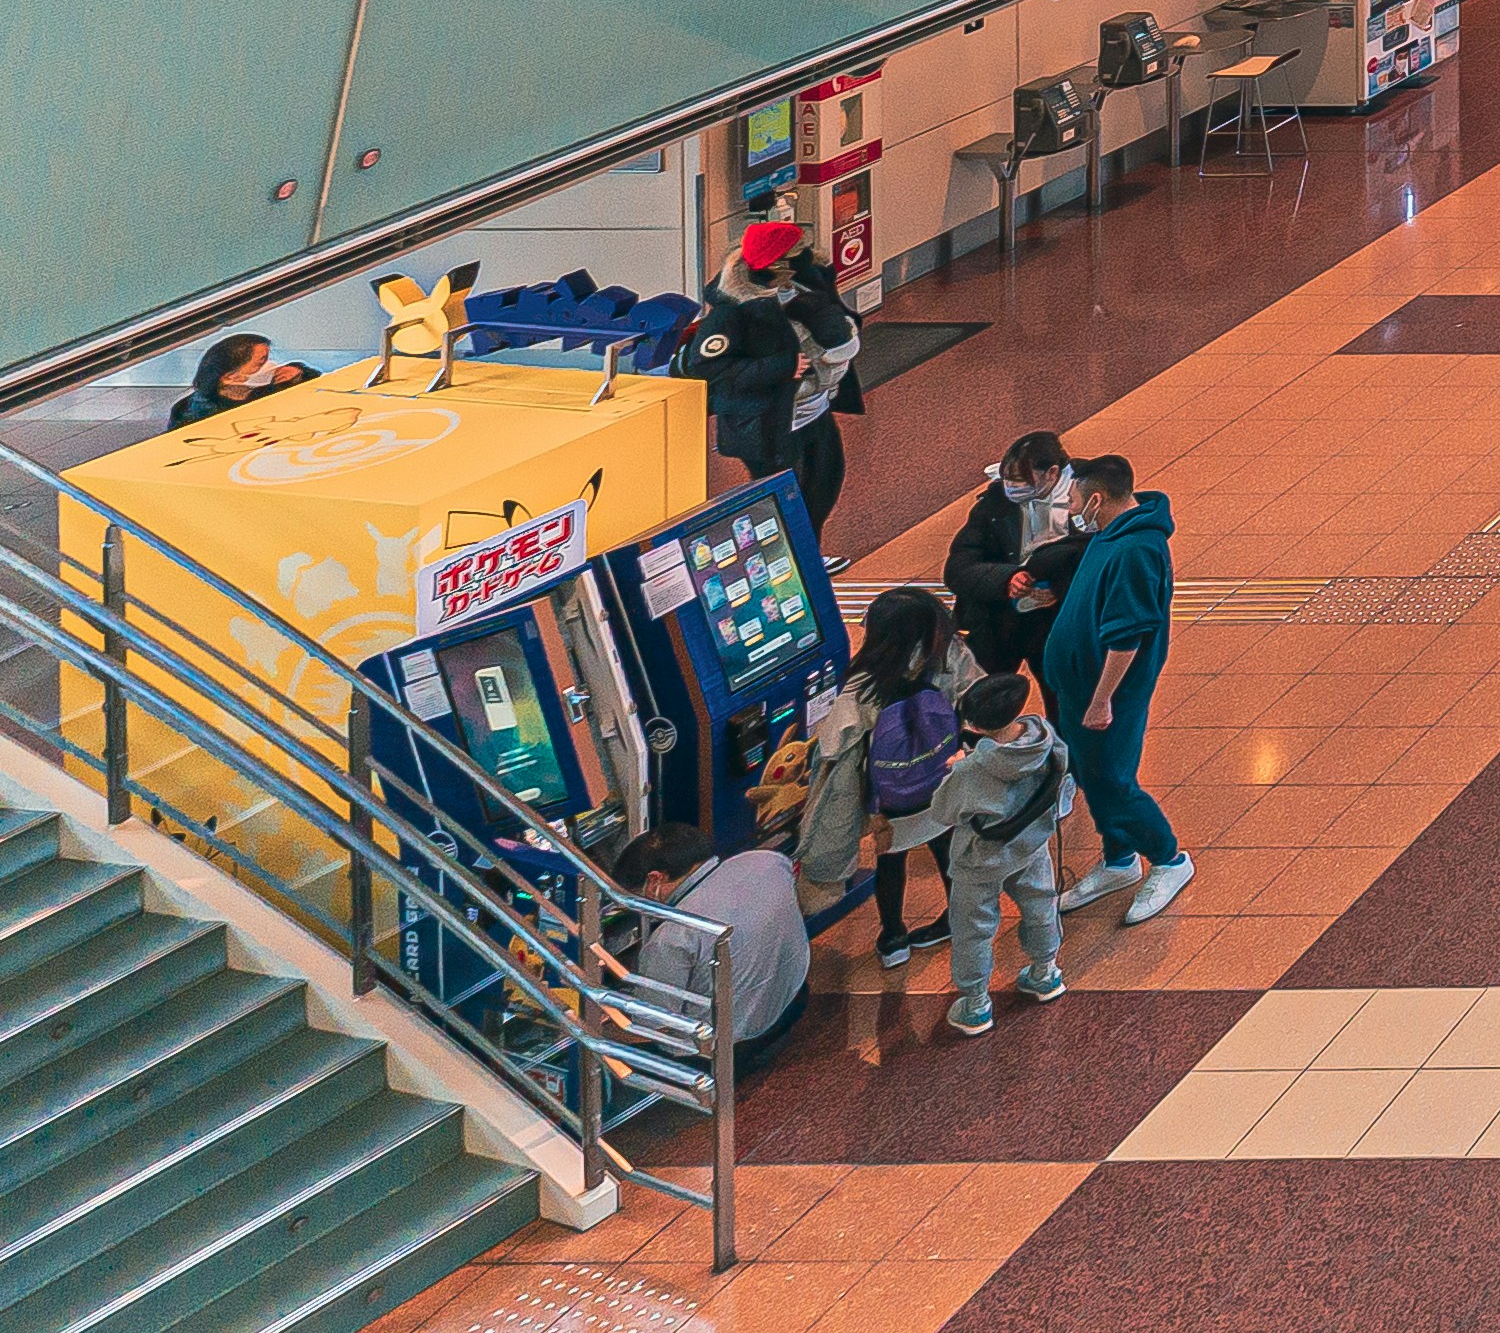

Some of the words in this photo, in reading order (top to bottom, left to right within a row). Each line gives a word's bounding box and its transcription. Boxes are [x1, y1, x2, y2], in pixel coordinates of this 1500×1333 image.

[802, 103, 816, 157] AED
[839, 223, 865, 244] AED
[434, 513, 574, 598] ポケモン
[443, 550, 563, 619] カードゲーム
